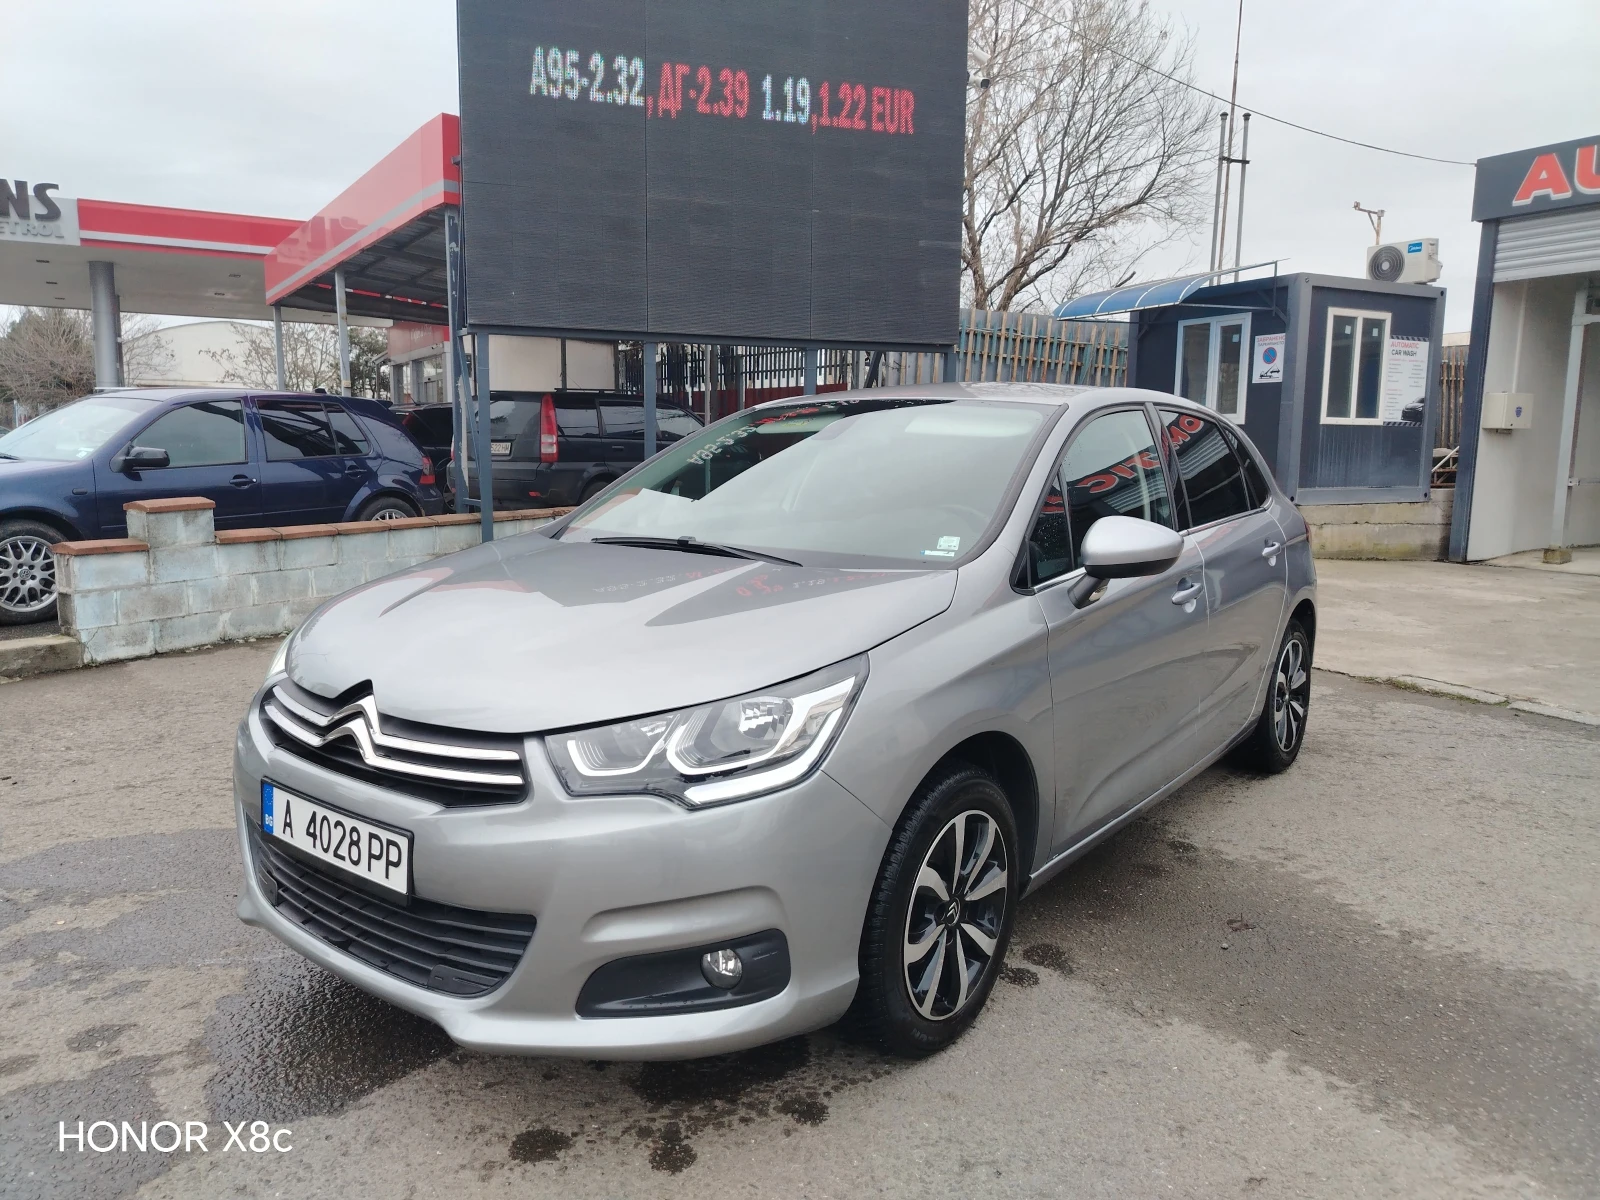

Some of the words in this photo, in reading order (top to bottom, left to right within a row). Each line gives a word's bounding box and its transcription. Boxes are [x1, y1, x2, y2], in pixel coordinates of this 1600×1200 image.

[871, 86, 915, 135] EUR
[1390, 341, 1420, 349] AUTOMATIC
[1403, 349, 1417, 357] WASH
[282, 798, 294, 839] A
